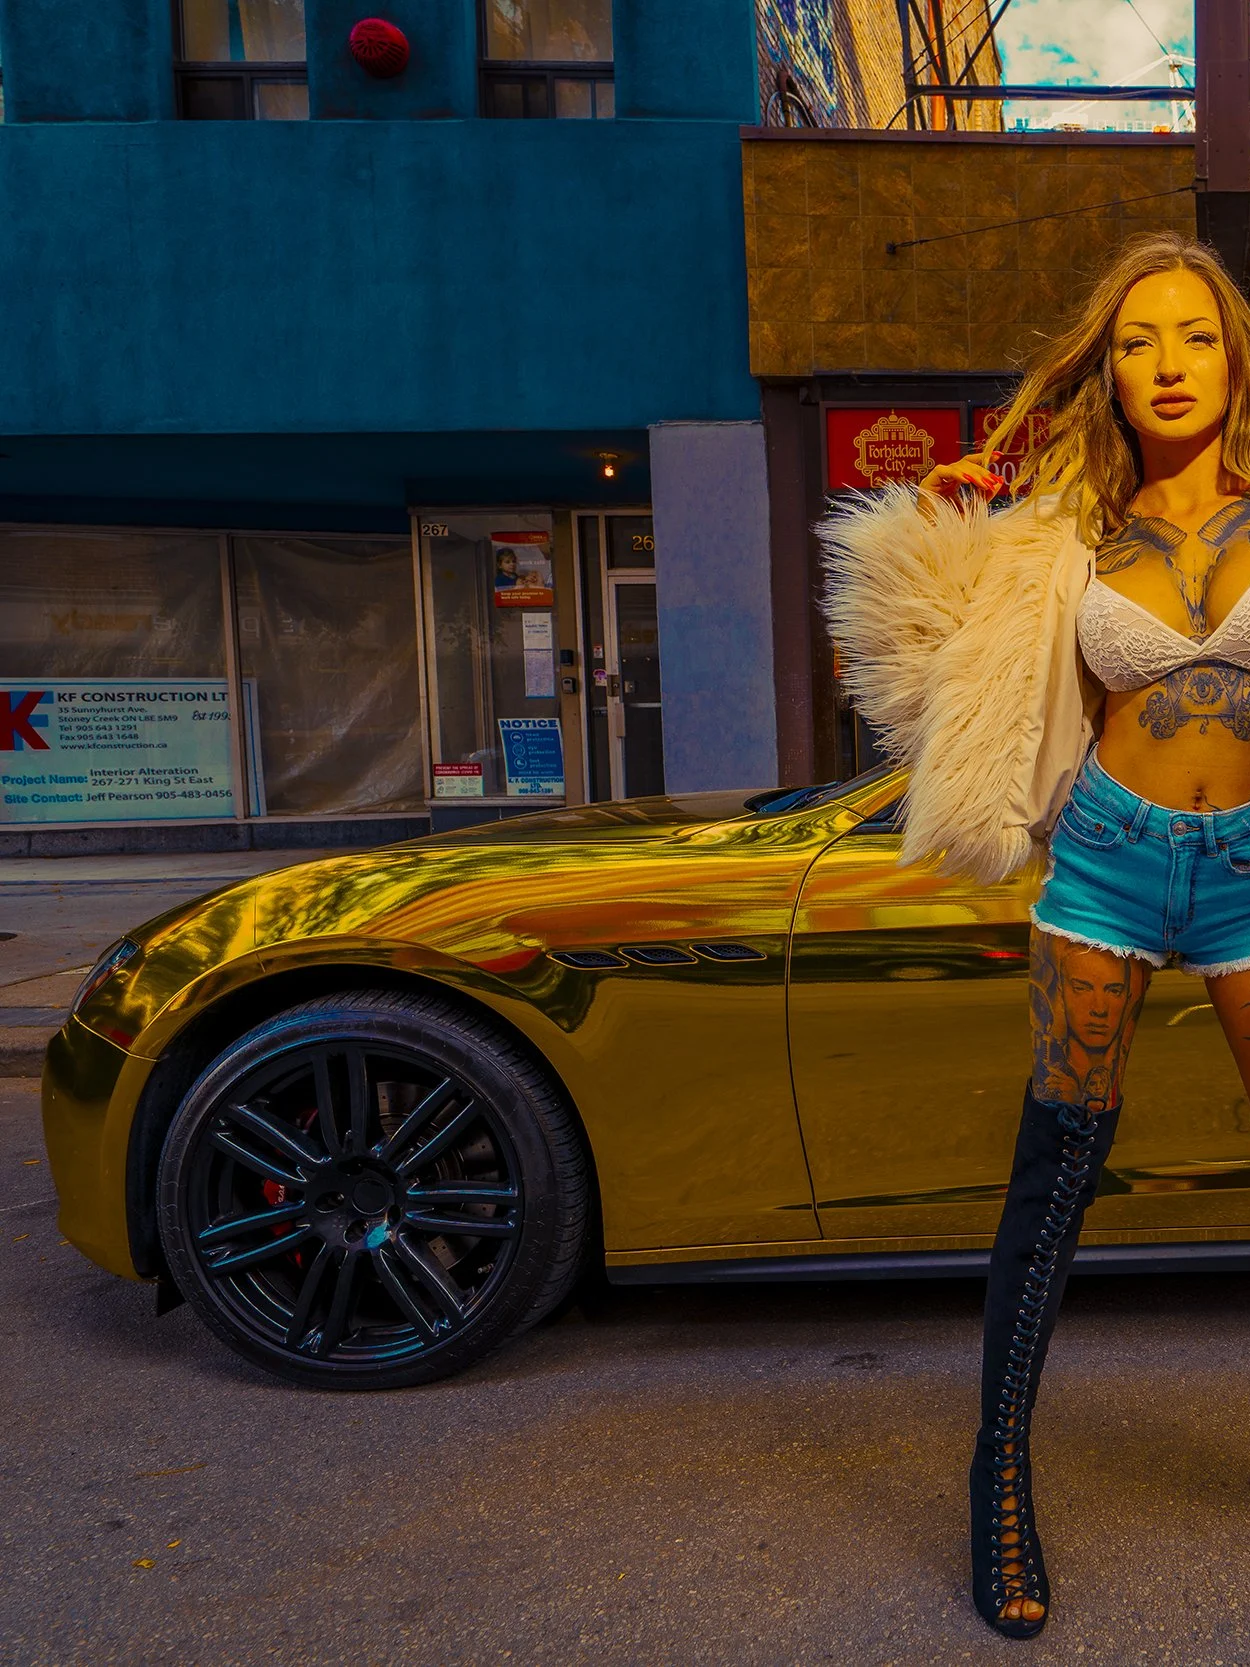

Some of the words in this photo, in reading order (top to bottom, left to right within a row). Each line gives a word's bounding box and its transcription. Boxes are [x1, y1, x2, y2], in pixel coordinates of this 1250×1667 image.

[868, 443, 921, 459] Forbidden
[884, 457, 906, 476] City
[422, 523, 448, 536] 267
[632, 535, 655, 551] 26
[57, 692, 76, 703] KF
[81, 692, 207, 703] CONSTRUCTION
[212, 691, 228, 702] LT
[71, 706, 126, 715] Sunnyhurst
[127, 706, 148, 714] Ave.
[192, 710, 207, 721] Est
[58, 715, 91, 723] Stoney
[499, 719, 558, 729] NOTICE
[60, 742, 168, 751] www.kfconstruction.ca
[90, 768, 136, 777] Interior
[138, 766, 199, 776] Alteration
[2, 775, 46, 786] Project
[49, 774, 88, 784] Name:
[91, 777, 139, 786] 267-271
[143, 776, 171, 786] King
[173, 775, 186, 784] St
[189, 775, 214, 784] East
[4, 794, 29, 804] Site
[31, 792, 83, 803] Contact:
[86, 792, 106, 801] Jeff
[108, 791, 154, 801] Pearson
[155, 789, 233, 800] 905-483-0456
